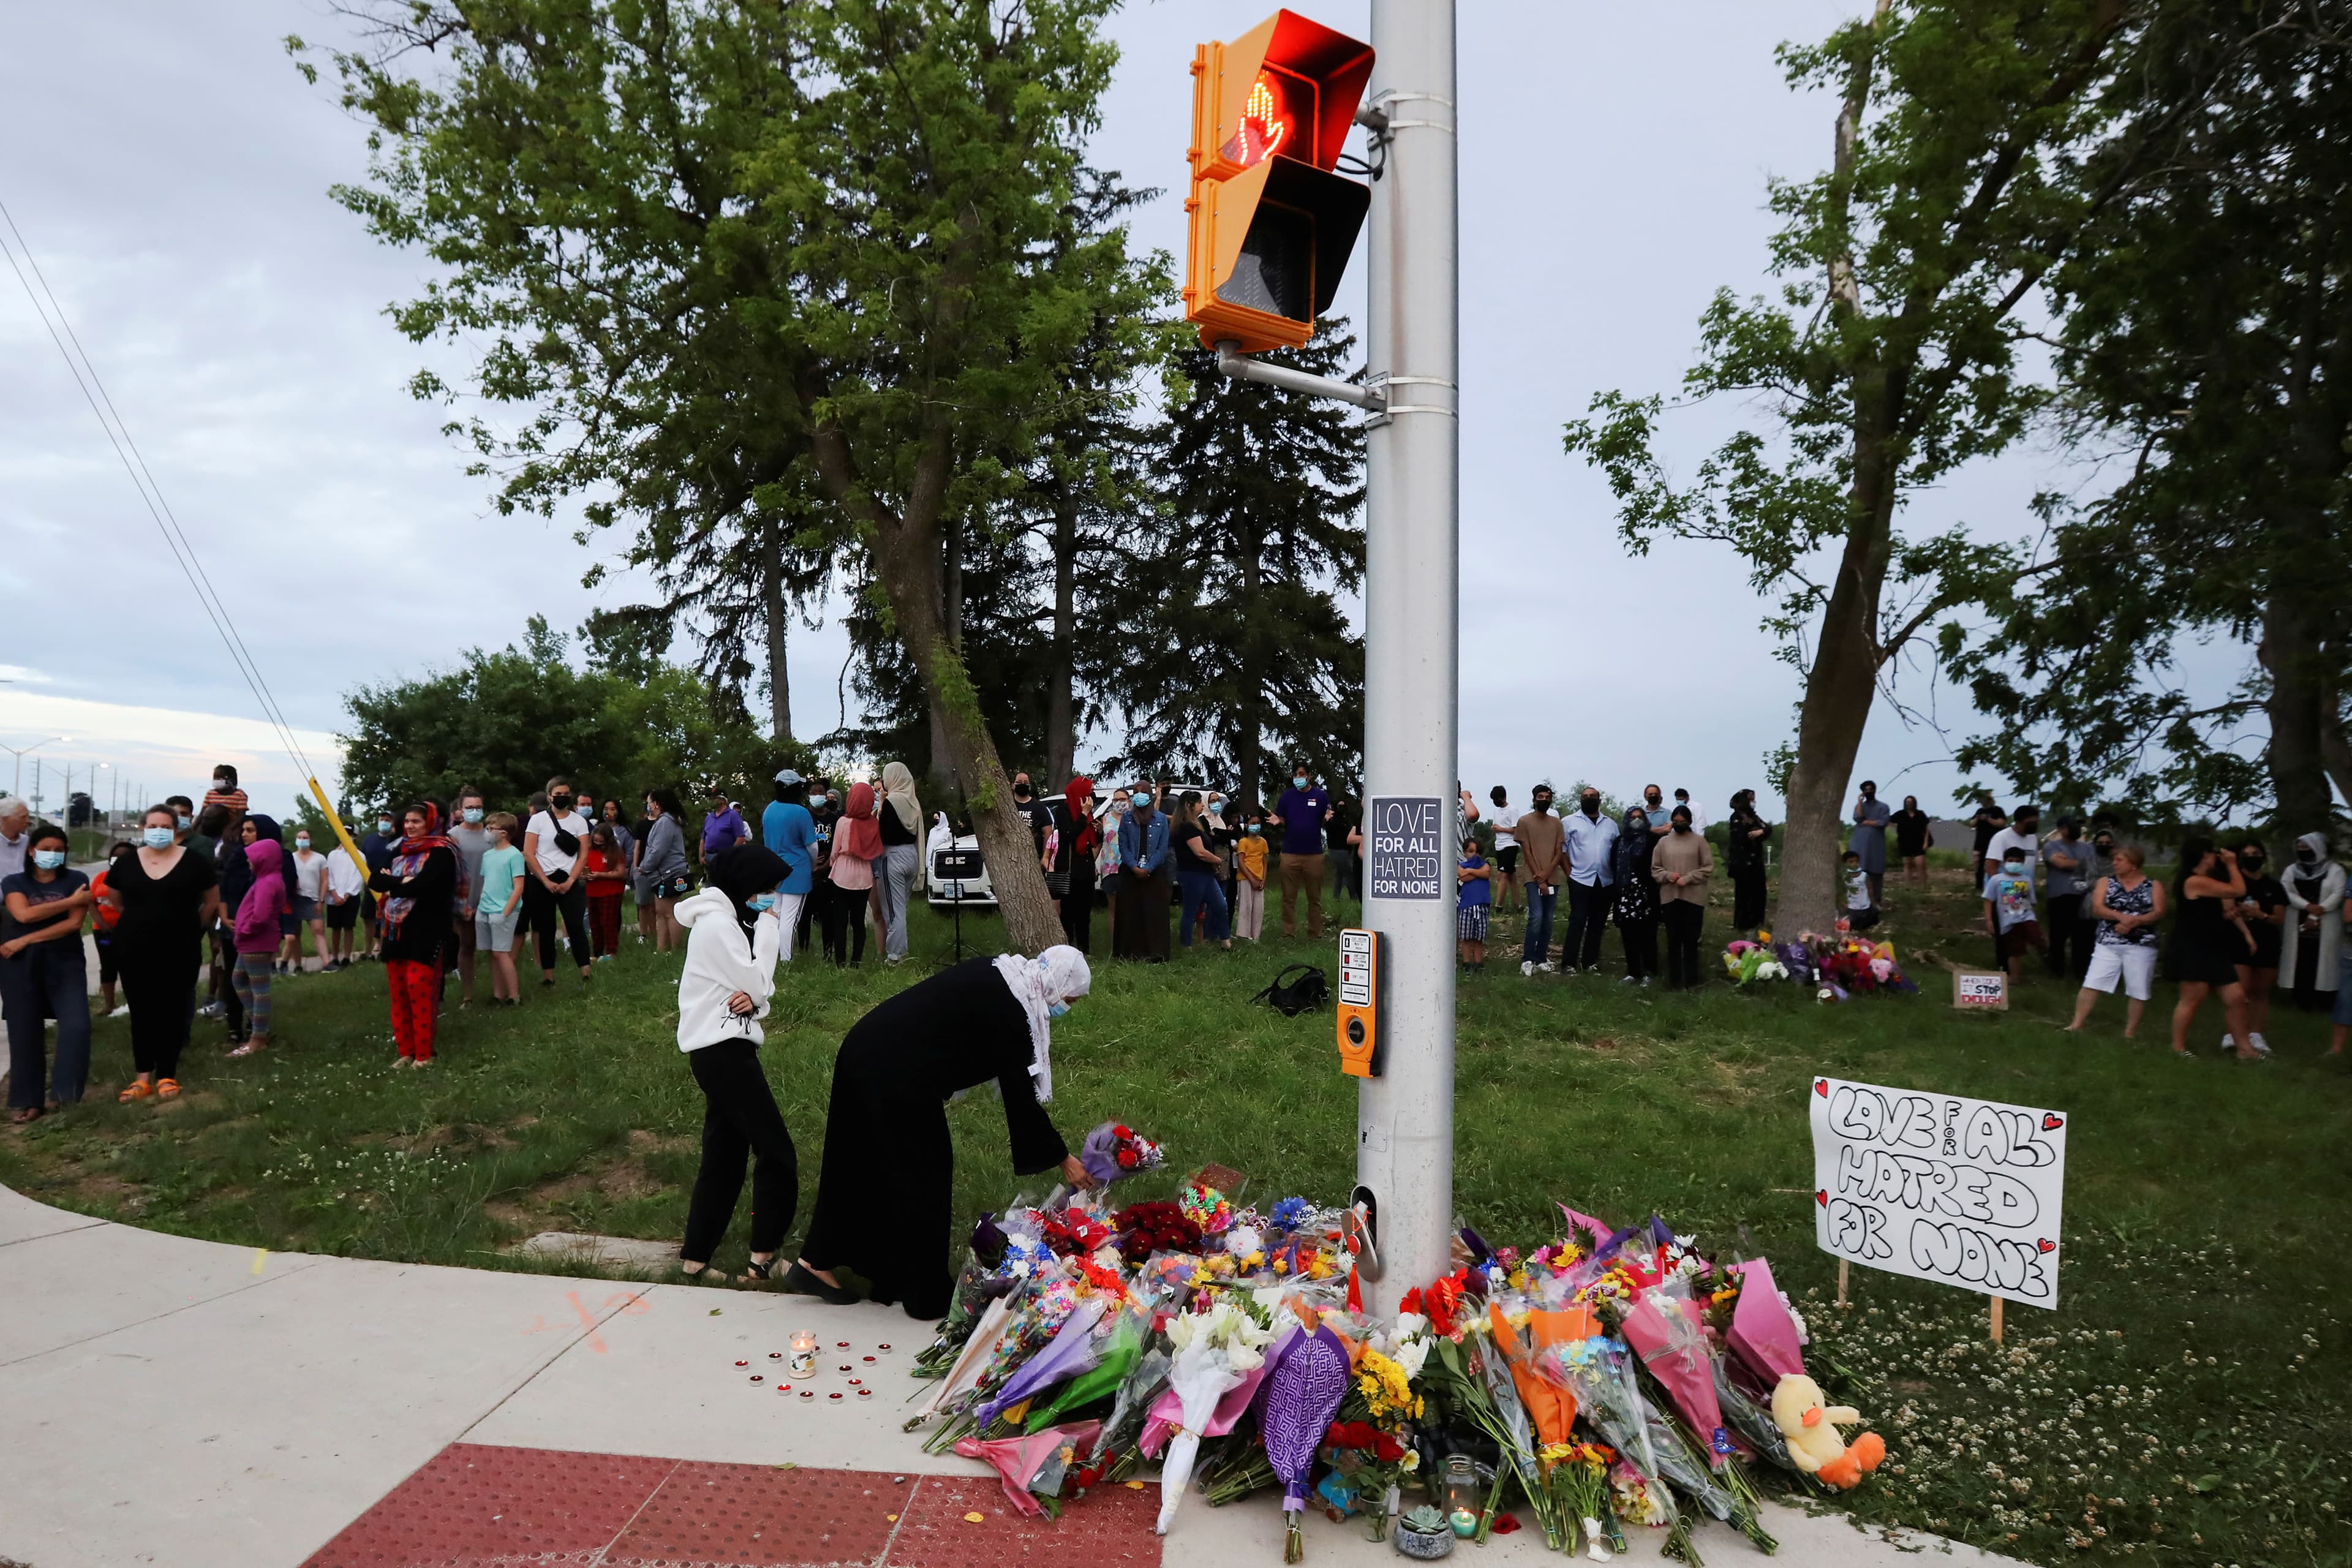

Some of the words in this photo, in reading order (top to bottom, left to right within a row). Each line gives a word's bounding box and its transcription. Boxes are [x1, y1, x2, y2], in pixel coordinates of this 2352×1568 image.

[1377, 803, 1437, 834] LOVE
[1375, 837, 1404, 853] FOR
[1409, 837, 1438, 853] ALL
[945, 856, 966, 865] GMC
[1374, 858, 1438, 878] HATRED
[1374, 880, 1398, 894] FOR
[1401, 881, 1438, 894] NONE
[1975, 985, 2001, 995] STOP
[1828, 1086, 1936, 1148] LOVE
[1942, 1101, 1962, 1156] FOR
[1964, 1106, 2056, 1167] ALL
[1838, 1145, 2038, 1228] HATRED
[1828, 1198, 1893, 1259] FOR
[1910, 1218, 2049, 1297] NONE
